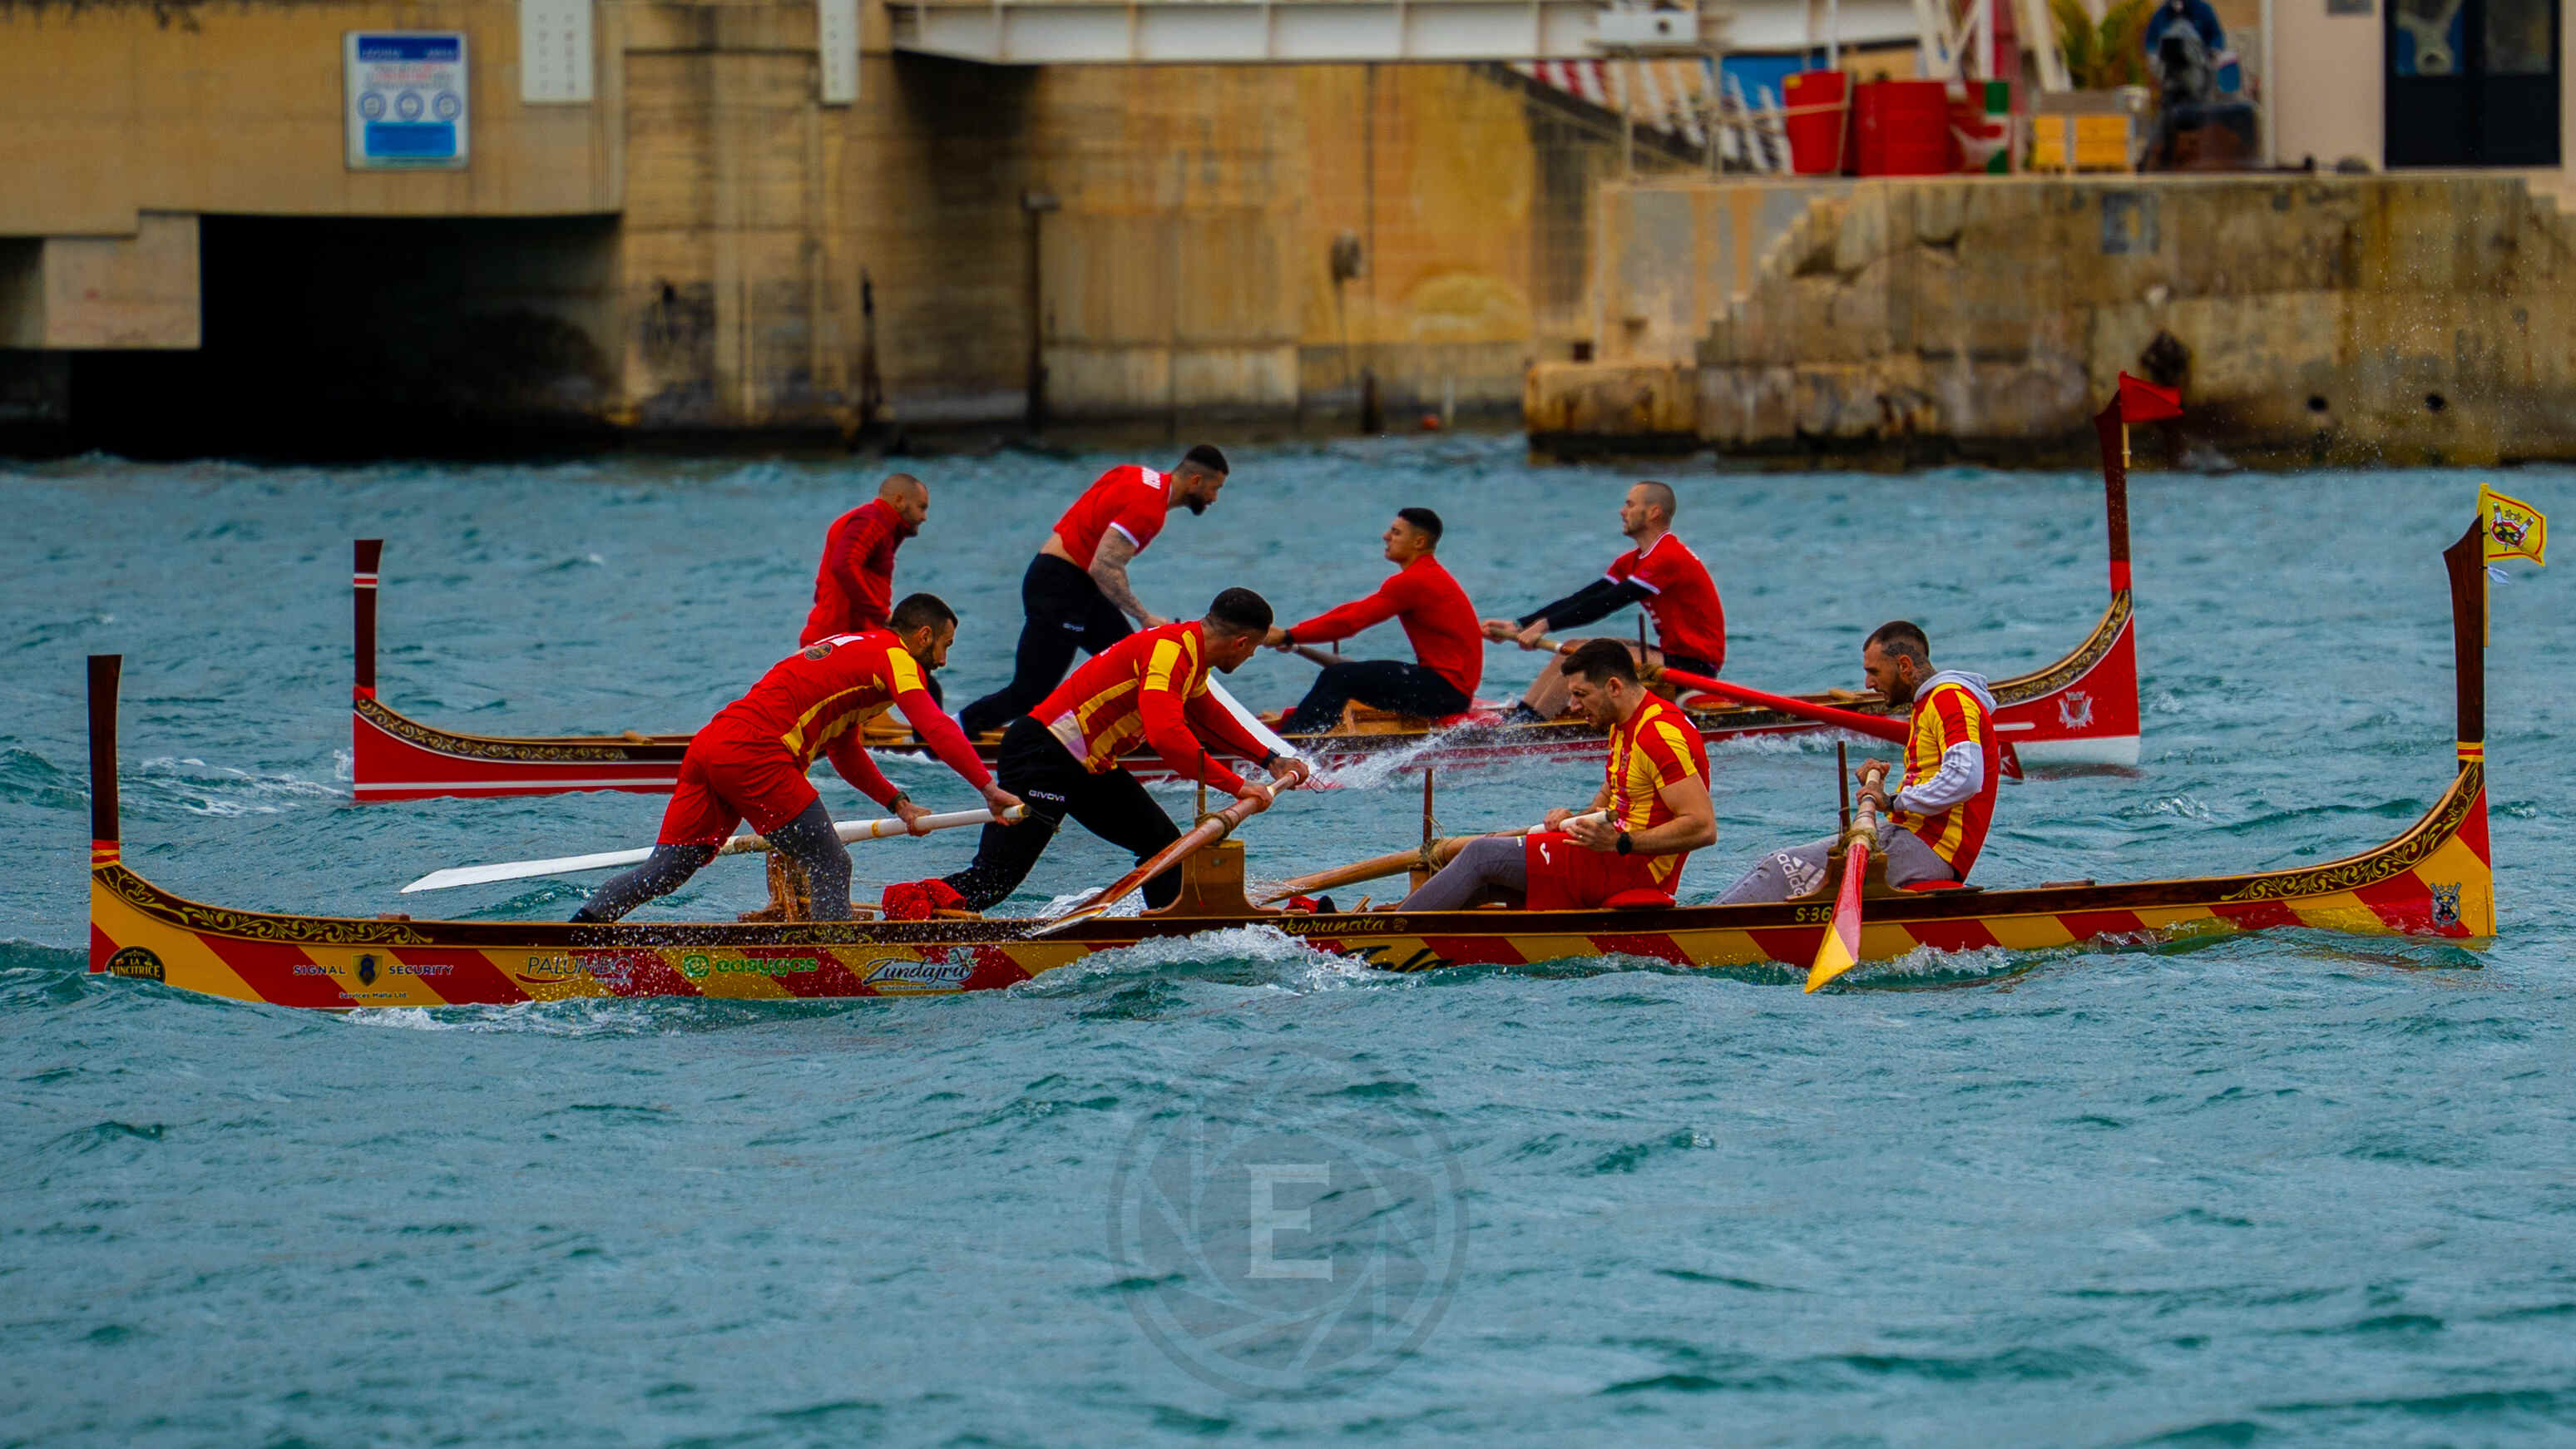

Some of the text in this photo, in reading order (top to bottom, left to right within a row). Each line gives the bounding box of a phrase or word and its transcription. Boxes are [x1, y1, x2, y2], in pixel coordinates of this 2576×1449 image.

[1777, 853, 1805, 896] adida
[293, 964, 346, 976] SIGNAL
[388, 965, 453, 976] SECURITY
[527, 956, 634, 975] PALUMBO
